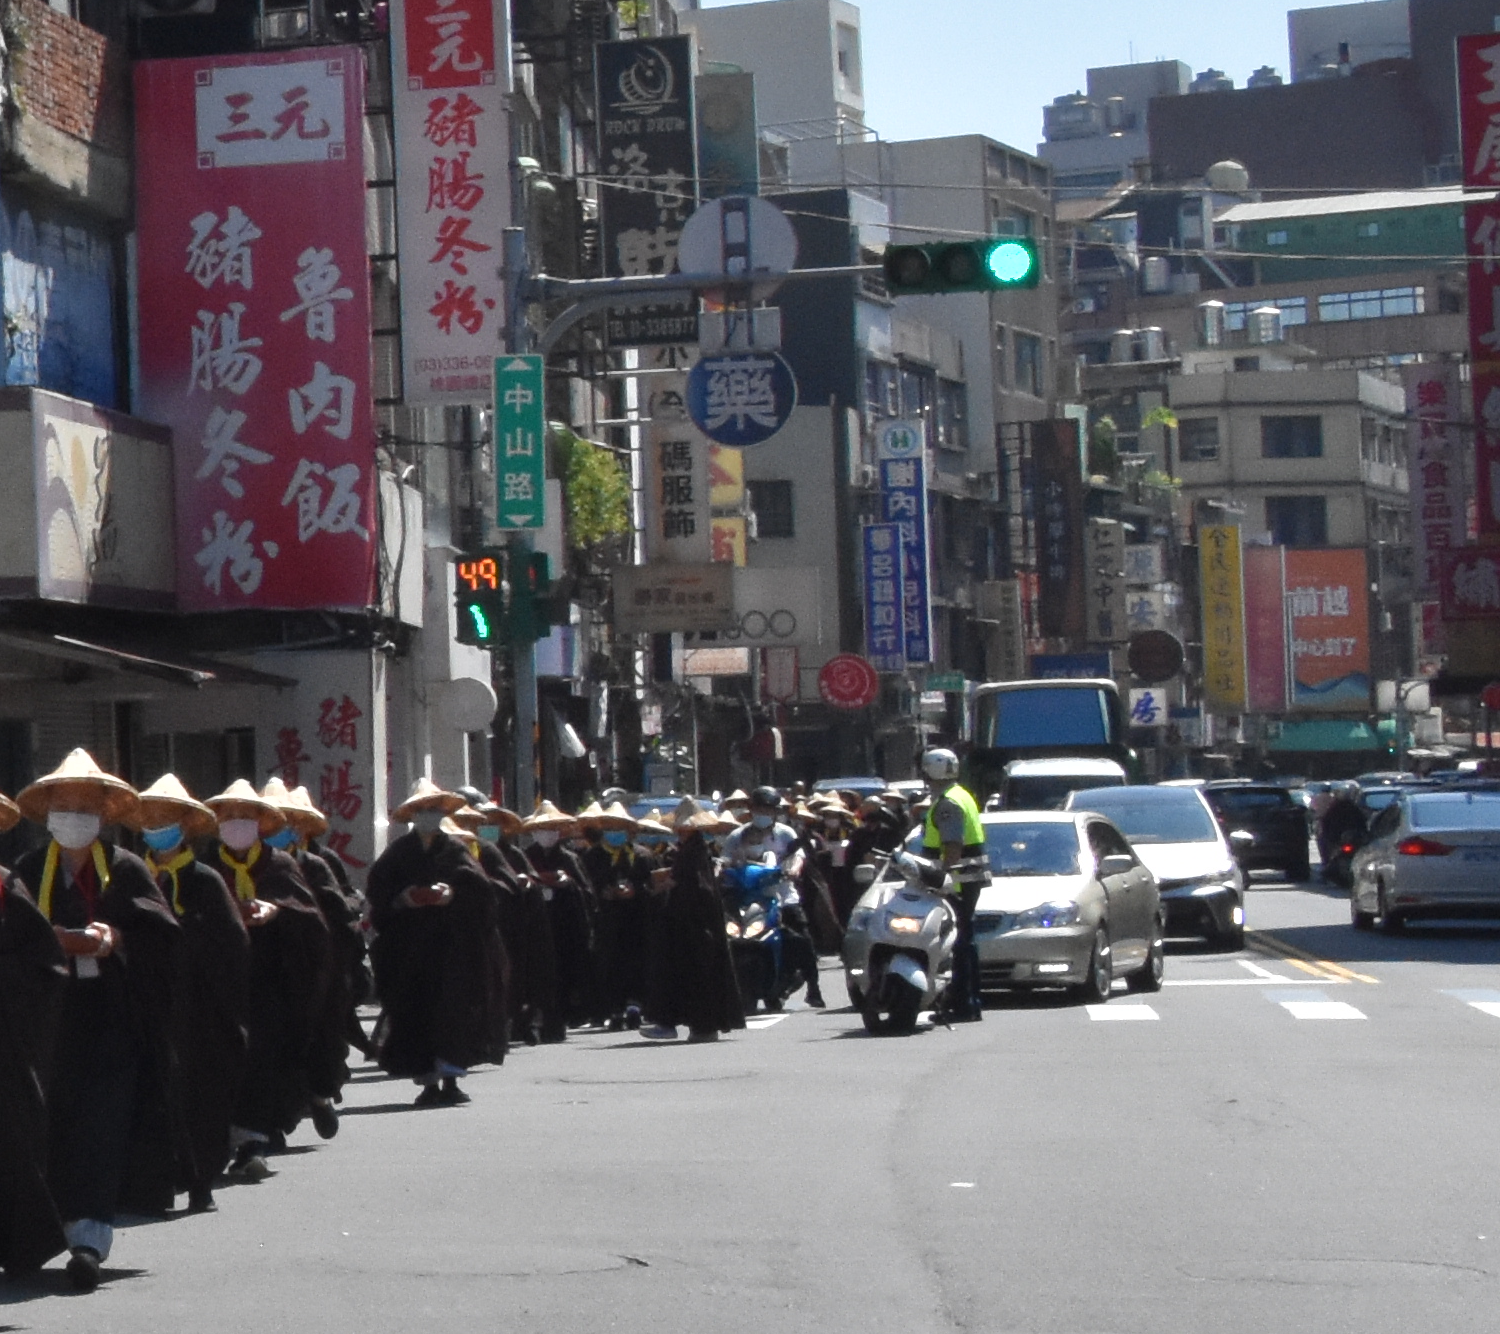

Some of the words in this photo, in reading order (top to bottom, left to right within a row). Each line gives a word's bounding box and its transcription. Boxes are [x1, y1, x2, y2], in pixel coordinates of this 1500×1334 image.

[214, 85, 330, 144] 三元
[422, 97, 497, 336] 豬腸冬粉
[185, 205, 279, 597] 豬腸冬粉
[279, 246, 370, 542] 魯肉飯
[503, 382, 534, 501] 中山路
[459, 558, 497, 591] 49
